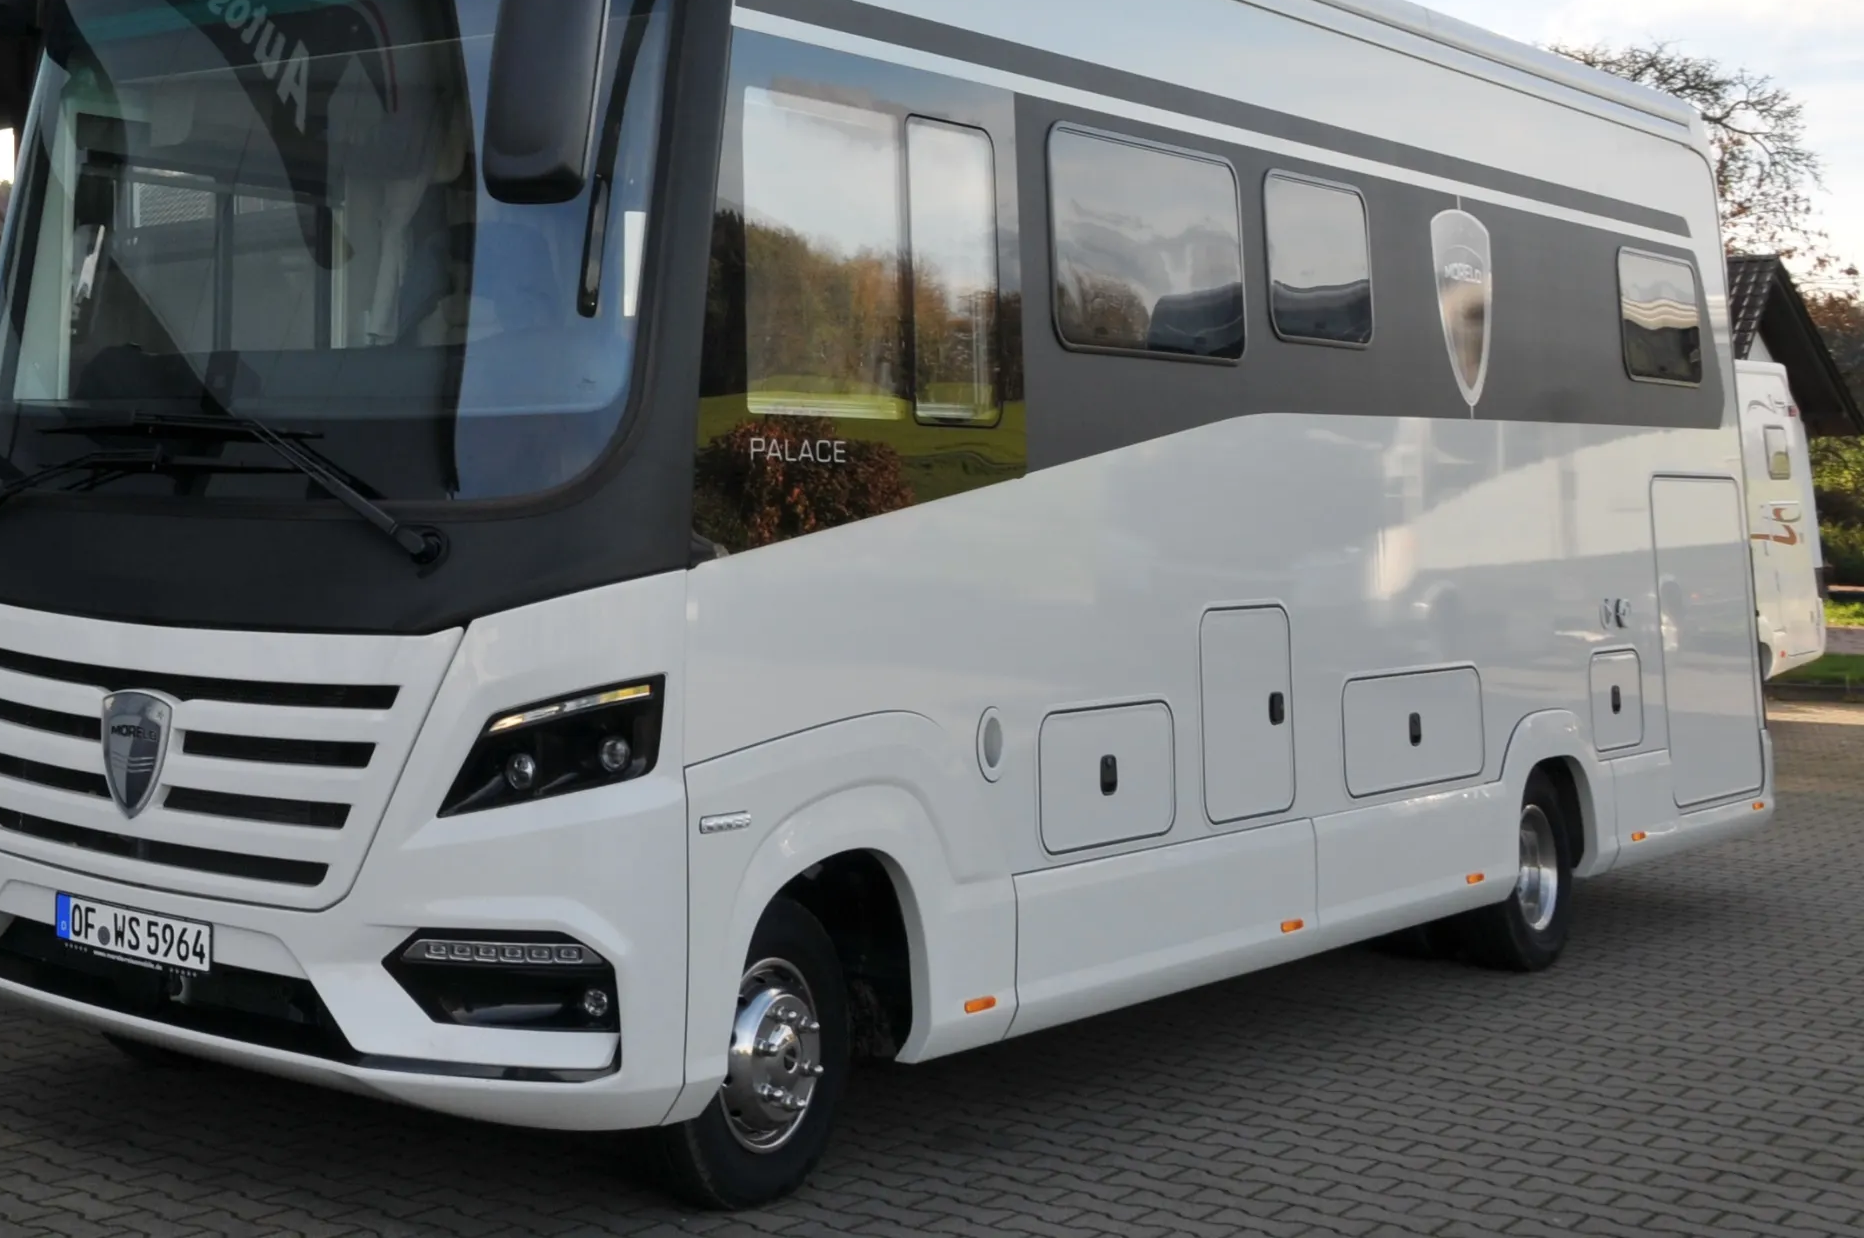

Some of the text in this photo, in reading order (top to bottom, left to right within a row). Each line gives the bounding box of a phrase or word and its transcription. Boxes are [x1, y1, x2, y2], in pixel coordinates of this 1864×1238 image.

[1444, 262, 1483, 284] MORELO
[749, 437, 846, 463] PALACE
[111, 724, 157, 741] MORELO
[71, 903, 96, 940] OF
[113, 912, 140, 951] WS
[147, 920, 206, 965] 5964
